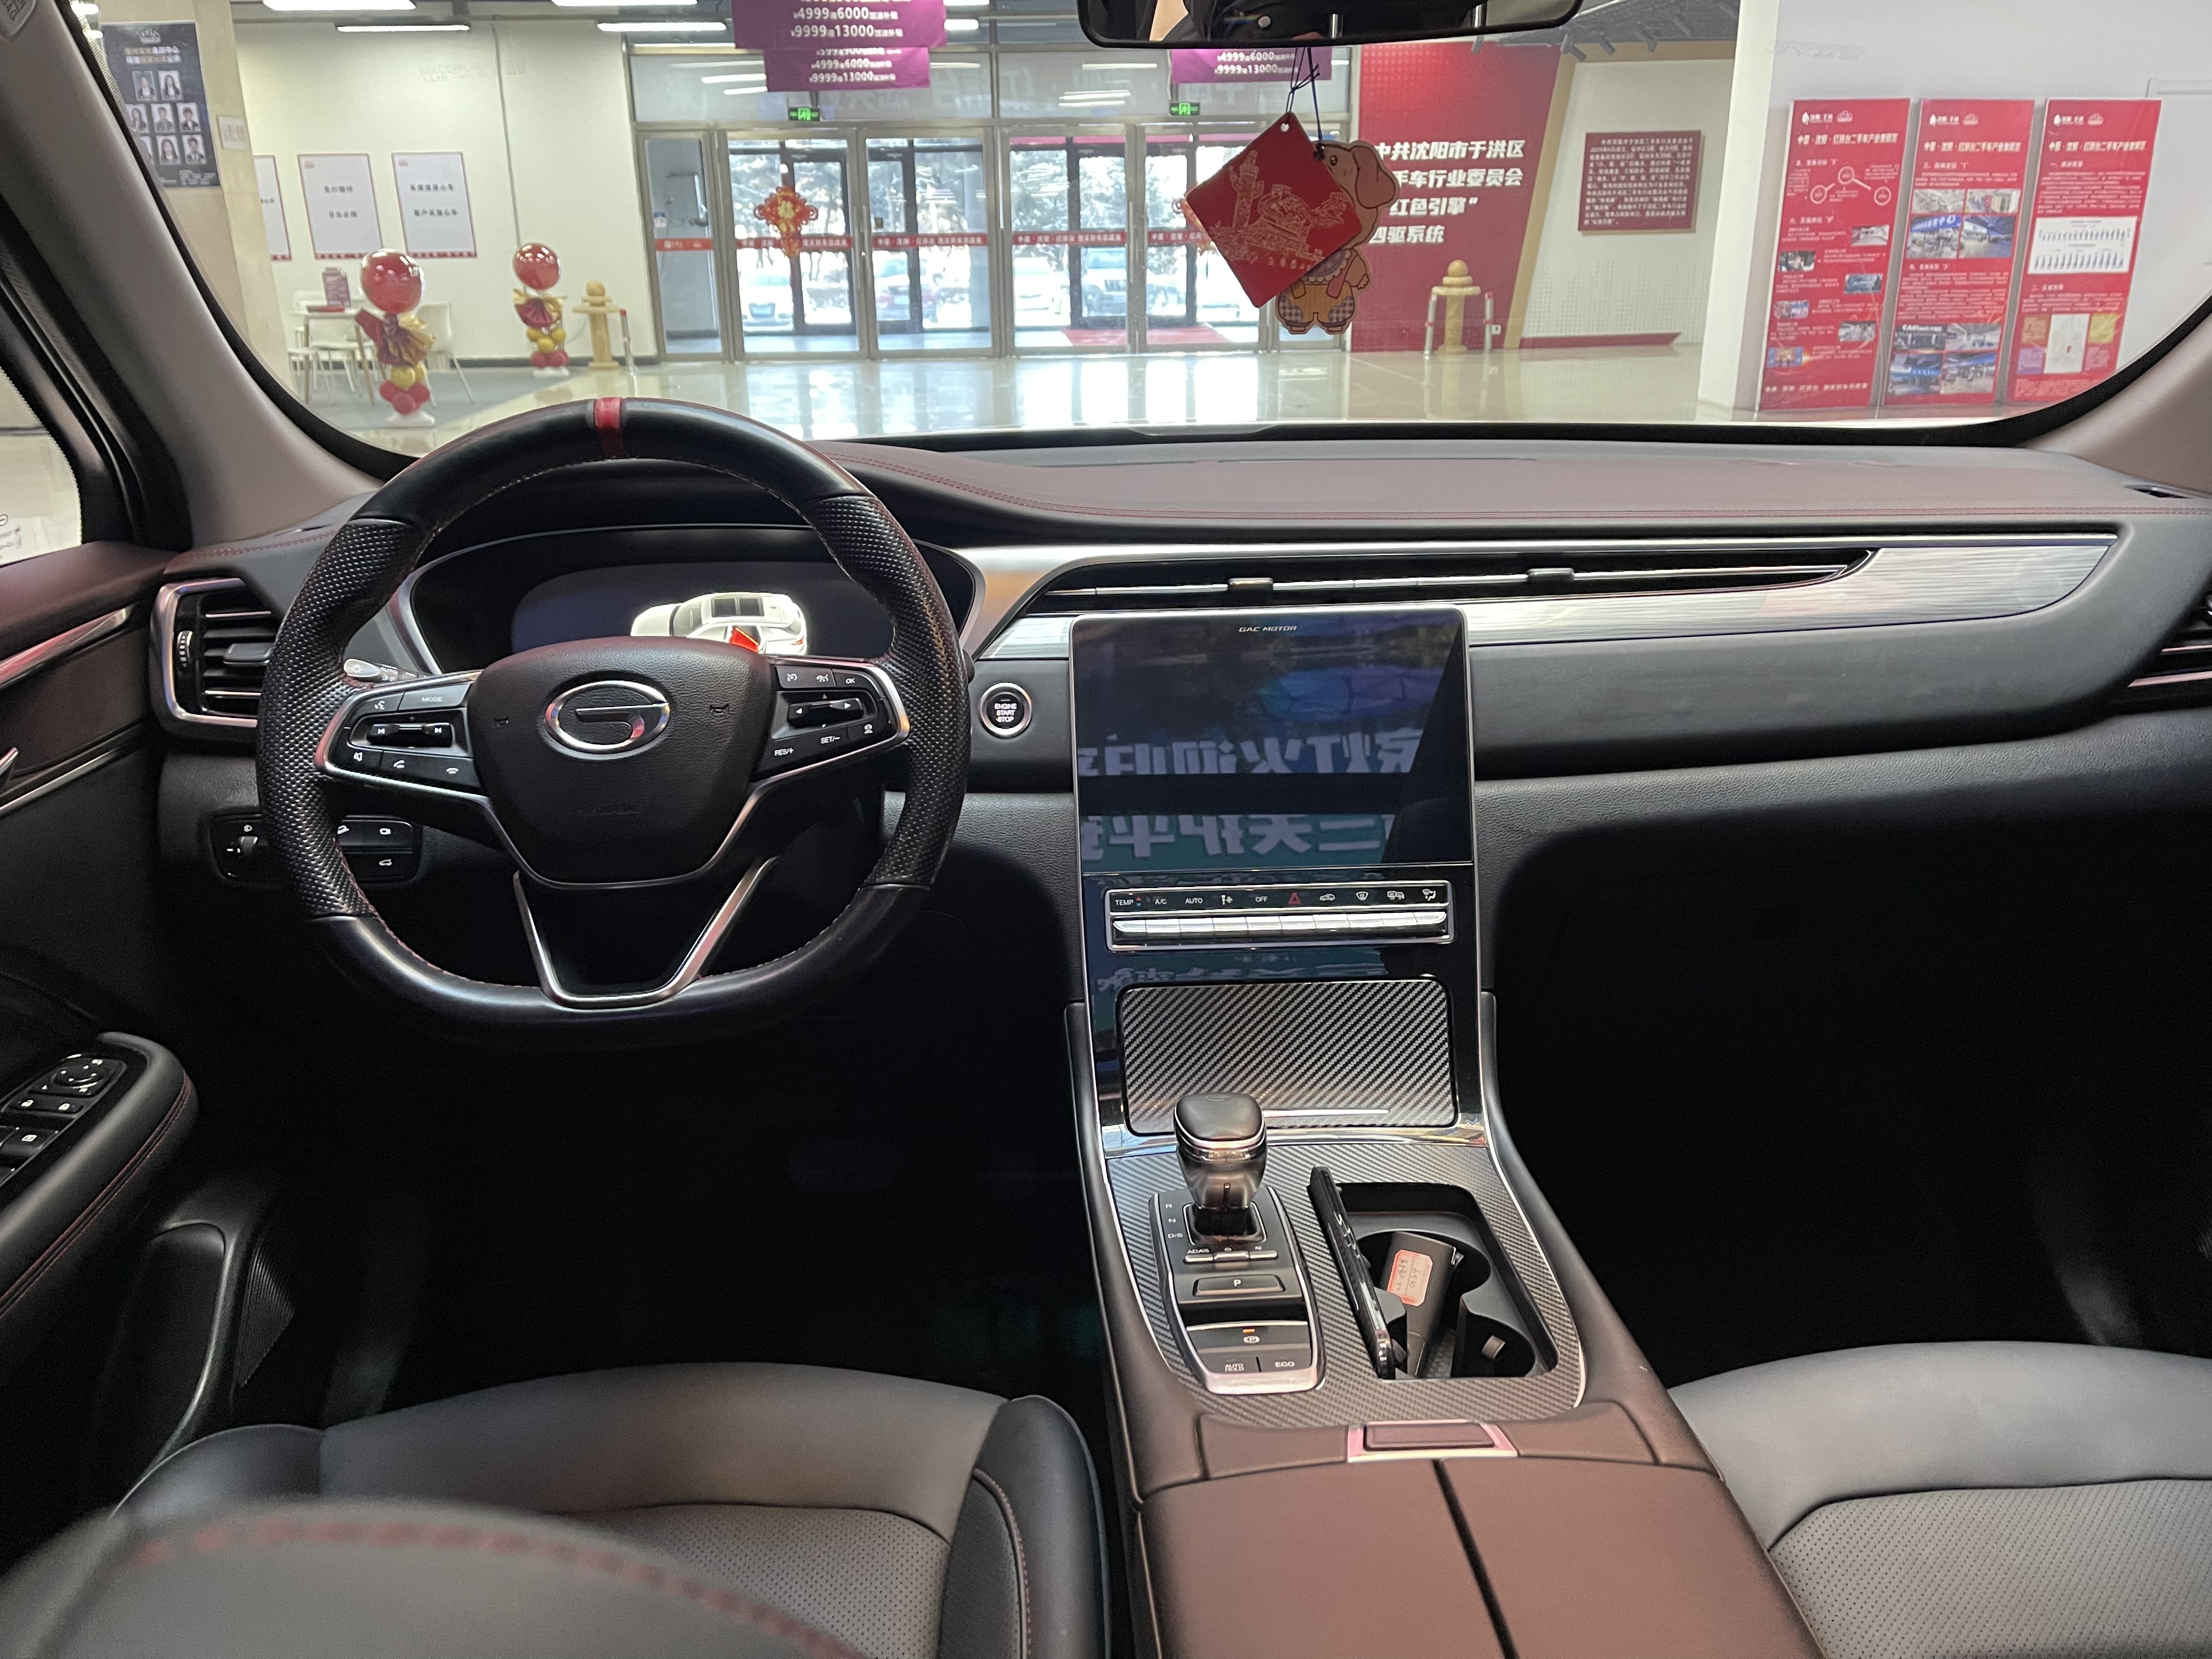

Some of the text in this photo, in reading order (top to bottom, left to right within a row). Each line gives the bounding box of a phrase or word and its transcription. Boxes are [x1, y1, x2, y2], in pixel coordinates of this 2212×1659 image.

[1375, 140, 1525, 160] 中共沈阳市于洪区
[1369, 225, 1445, 244] 四驱系统
[774, 747, 794, 757] RES/+
